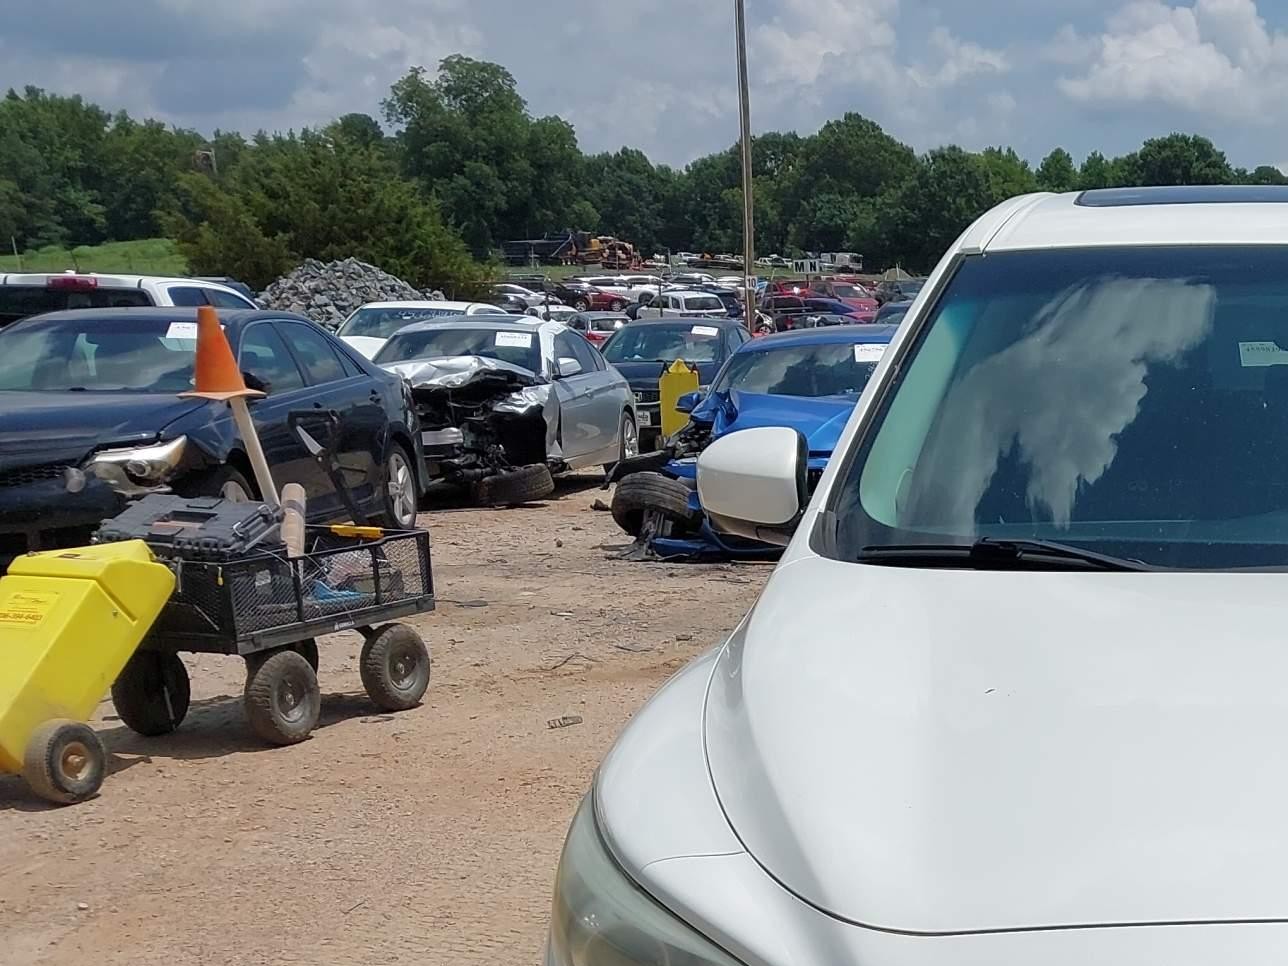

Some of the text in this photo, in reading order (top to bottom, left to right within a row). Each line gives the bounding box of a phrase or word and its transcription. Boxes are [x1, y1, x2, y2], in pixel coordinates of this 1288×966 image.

[794, 261, 817, 273] M N
[747, 278, 757, 288] 10
